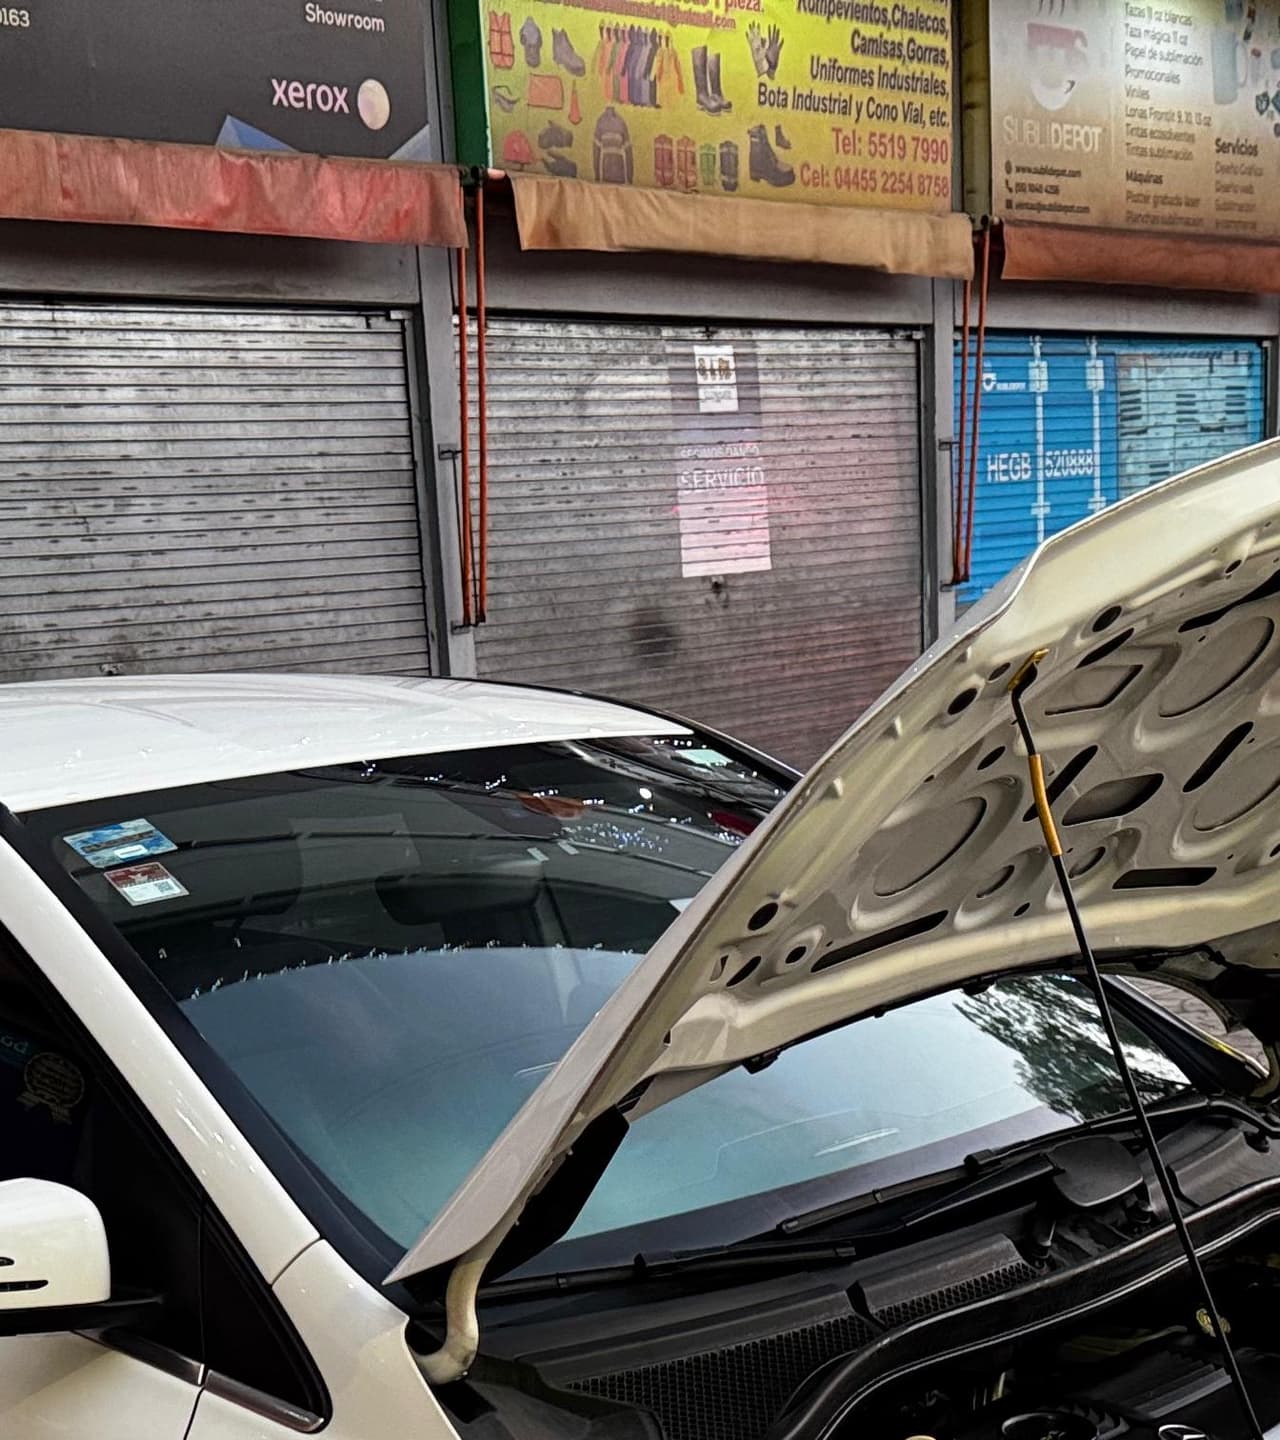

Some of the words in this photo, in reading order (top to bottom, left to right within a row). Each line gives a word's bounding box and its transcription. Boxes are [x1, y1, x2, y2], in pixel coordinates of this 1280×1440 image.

[304, 2, 386, 33] Showroom
[810, 55, 875, 88] Uniformes
[878, 64, 950, 102] Industriales,
[271, 78, 351, 115] xerox
[758, 82, 789, 109] Bota
[792, 86, 853, 116] Industrial
[855, 101, 864, 124] y
[866, 96, 899, 122] Cono
[902, 101, 926, 129] Vial,
[929, 109, 951, 128] etc.
[831, 127, 862, 157] Tel:
[868, 131, 907, 161] 5519
[912, 137, 950, 165] 7990
[1215, 137, 1259, 157] Servicios
[799, 163, 832, 188] Cel:
[986, 452, 1032, 483] HEGB
